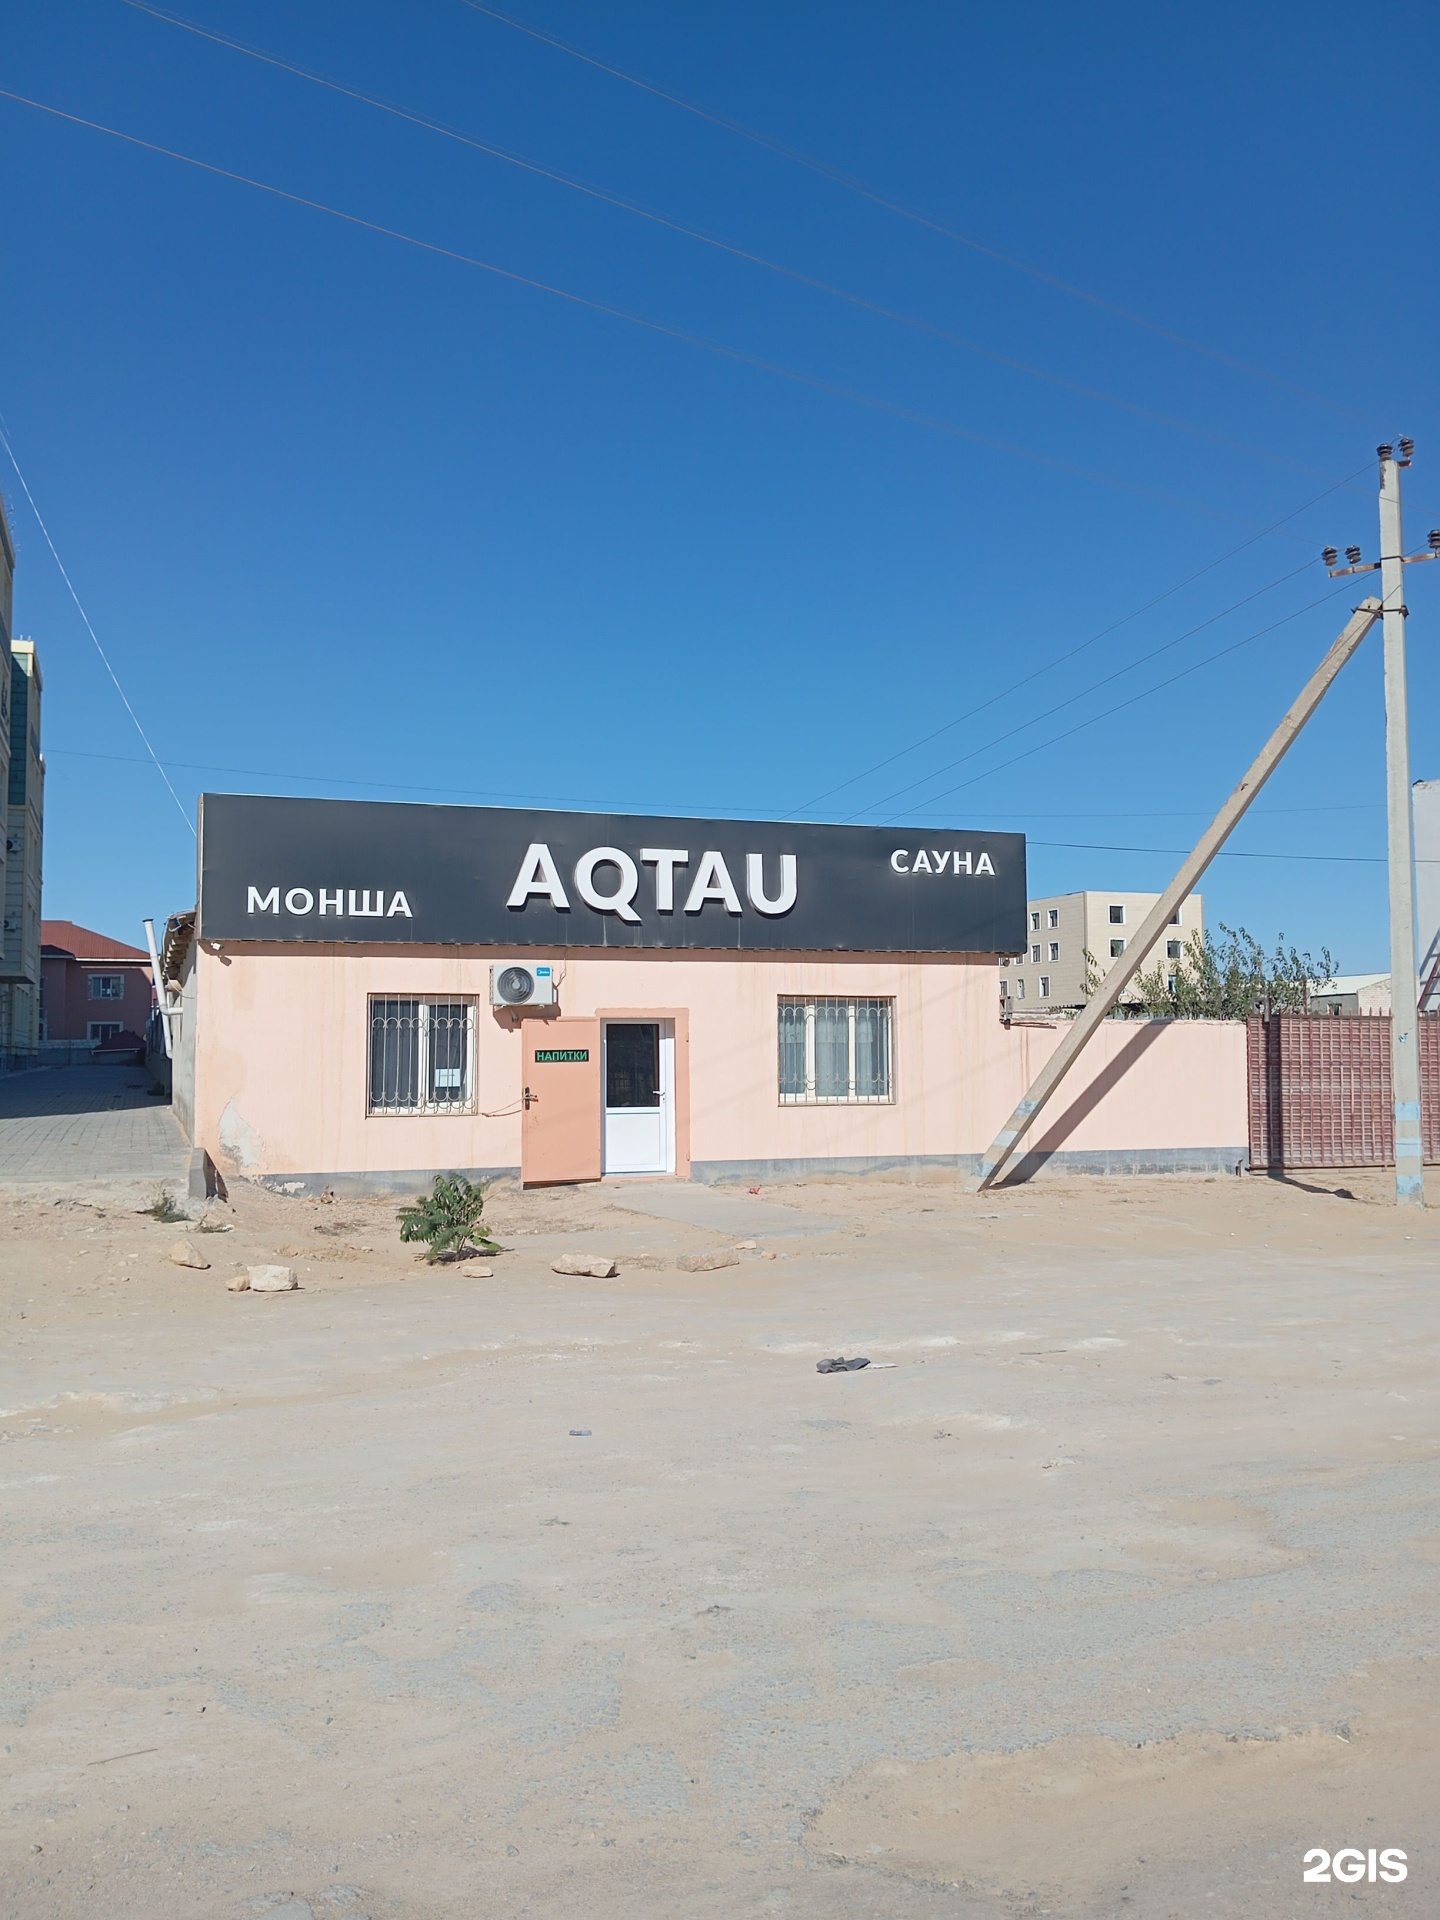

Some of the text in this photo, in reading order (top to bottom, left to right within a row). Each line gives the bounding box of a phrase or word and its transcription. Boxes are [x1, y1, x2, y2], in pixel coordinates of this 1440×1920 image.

[890, 849, 996, 876] САУНА
[505, 842, 798, 922] AQTAU
[247, 886, 413, 918] МОНША
[536, 1051, 587, 1061] НАПИТКИ
